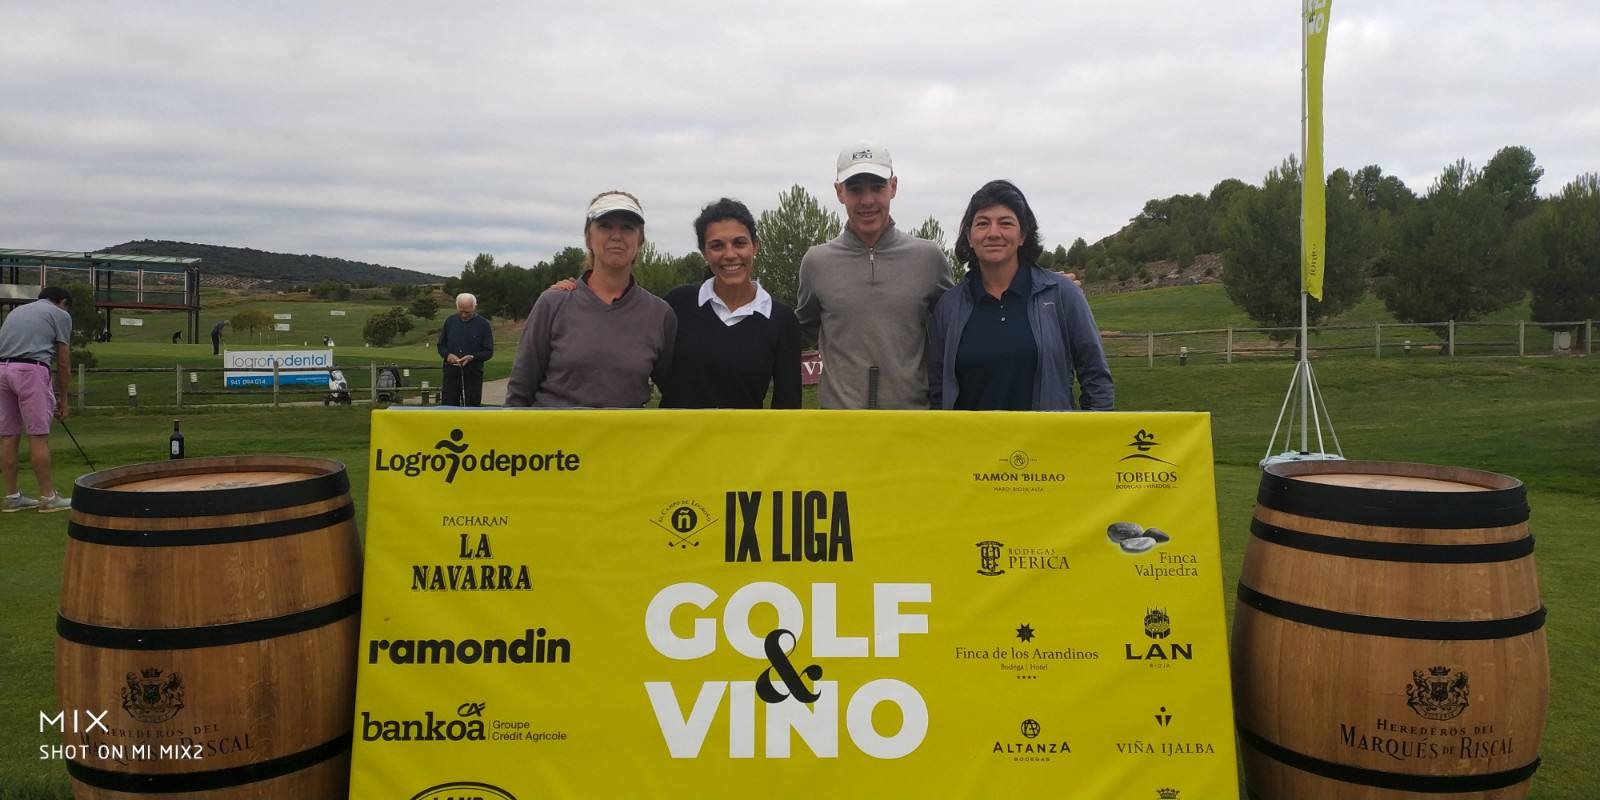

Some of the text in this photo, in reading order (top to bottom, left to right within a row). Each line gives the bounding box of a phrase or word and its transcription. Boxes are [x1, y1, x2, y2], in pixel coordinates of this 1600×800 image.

[480, 449, 580, 476] deporte
[973, 472, 1065, 482] RAMÓN BILBAO
[1115, 471, 1177, 483] TOBELOS
[442, 515, 509, 527] PACHARAN
[724, 490, 854, 562] IX LIGA
[459, 533, 493, 560] LA
[1008, 555, 1071, 570] PERICA
[1159, 552, 1198, 564] Finca
[411, 565, 533, 592] NAVARRA
[1135, 564, 1199, 580] Valpiedra
[645, 581, 932, 660] GOLF
[368, 628, 571, 664] ramondin
[956, 647, 1099, 661] Finca de los Arandinos
[1125, 643, 1193, 660] LAN
[755, 629, 823, 704] &
[361, 711, 486, 742] bankoa
[492, 720, 530, 731] Groupe
[643, 678, 929, 759] VINO
[193, 723, 220, 735] DEL
[1376, 718, 1495, 737] HEREDEROS DEL
[492, 731, 567, 742] Crédit Agricole
[1340, 723, 1439, 761] MARQUÉS
[1460, 736, 1514, 760] RISCAL
[993, 741, 1071, 753] ALTANZA
[1117, 740, 1215, 757] VIÑA IJALBA
